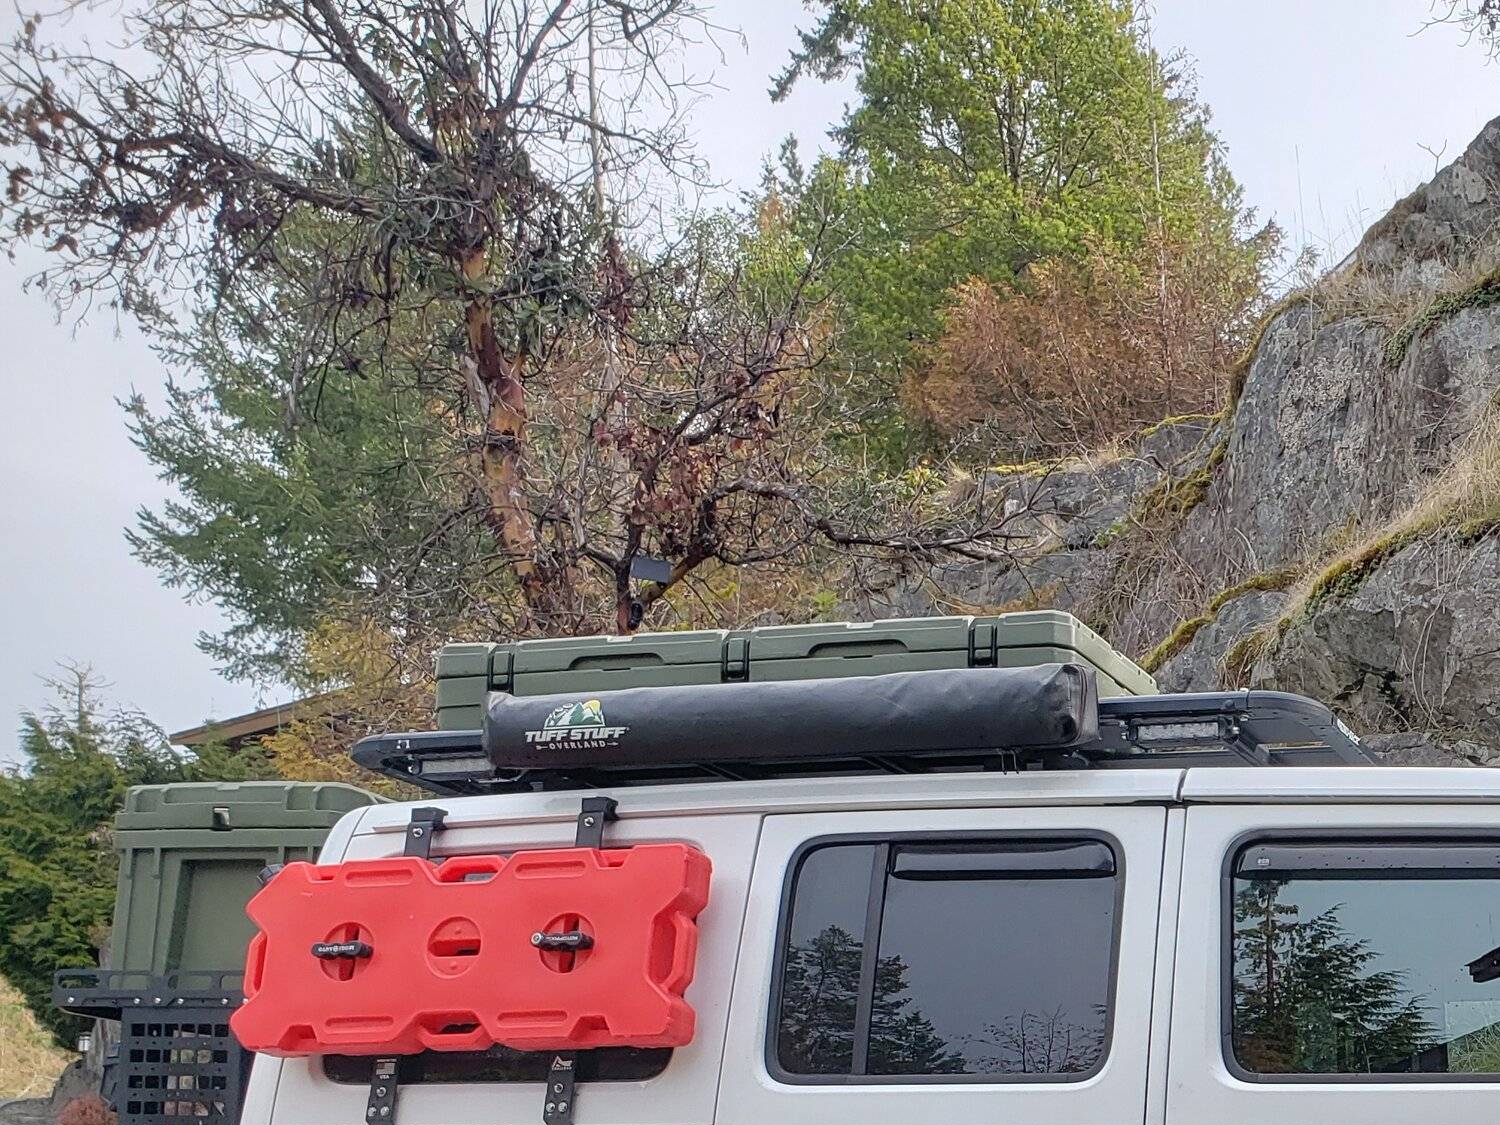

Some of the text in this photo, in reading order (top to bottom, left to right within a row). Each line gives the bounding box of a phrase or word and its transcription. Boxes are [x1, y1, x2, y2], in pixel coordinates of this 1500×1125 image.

[524, 727, 626, 743] TUFF STUFF
[549, 740, 606, 750] OVERLAND
